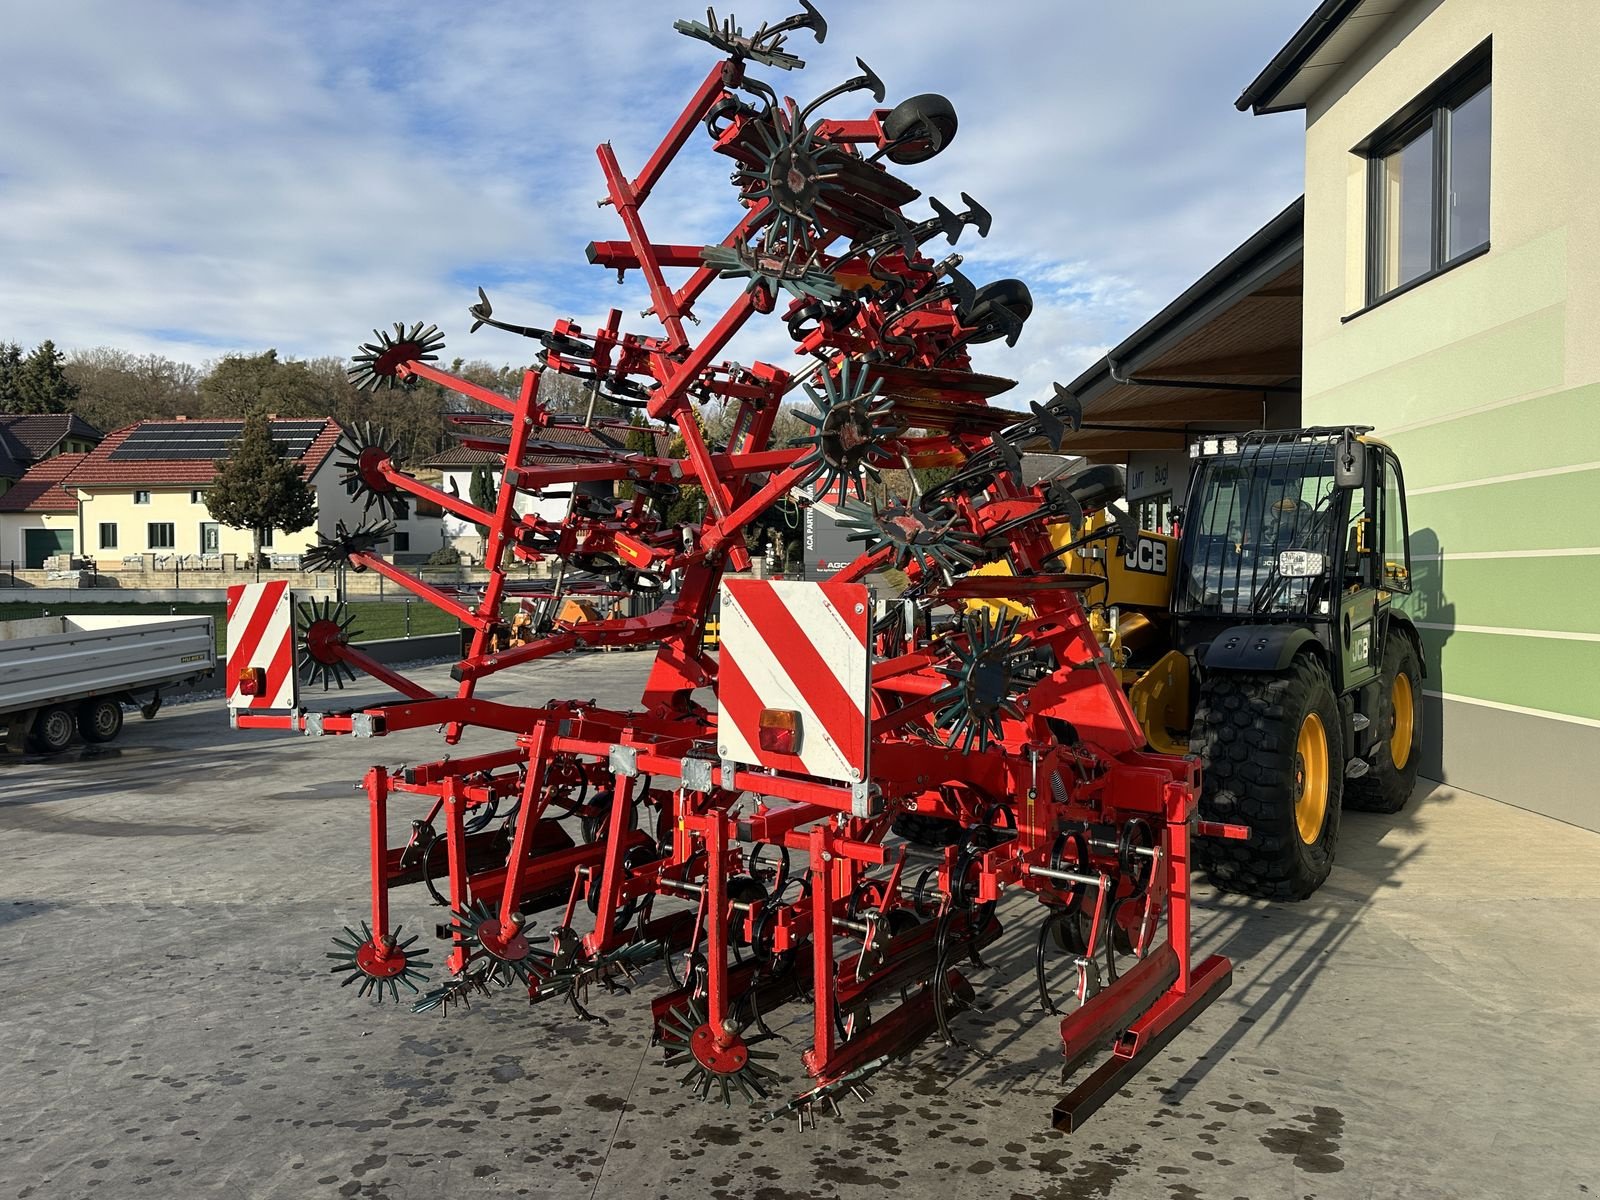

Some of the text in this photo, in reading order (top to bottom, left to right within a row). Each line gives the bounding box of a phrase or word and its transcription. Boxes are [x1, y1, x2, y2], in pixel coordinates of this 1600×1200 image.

[1132, 462, 1169, 489] LMT Bugl
[1125, 538, 1167, 573] JCB
[1352, 637, 1368, 662] JCB
